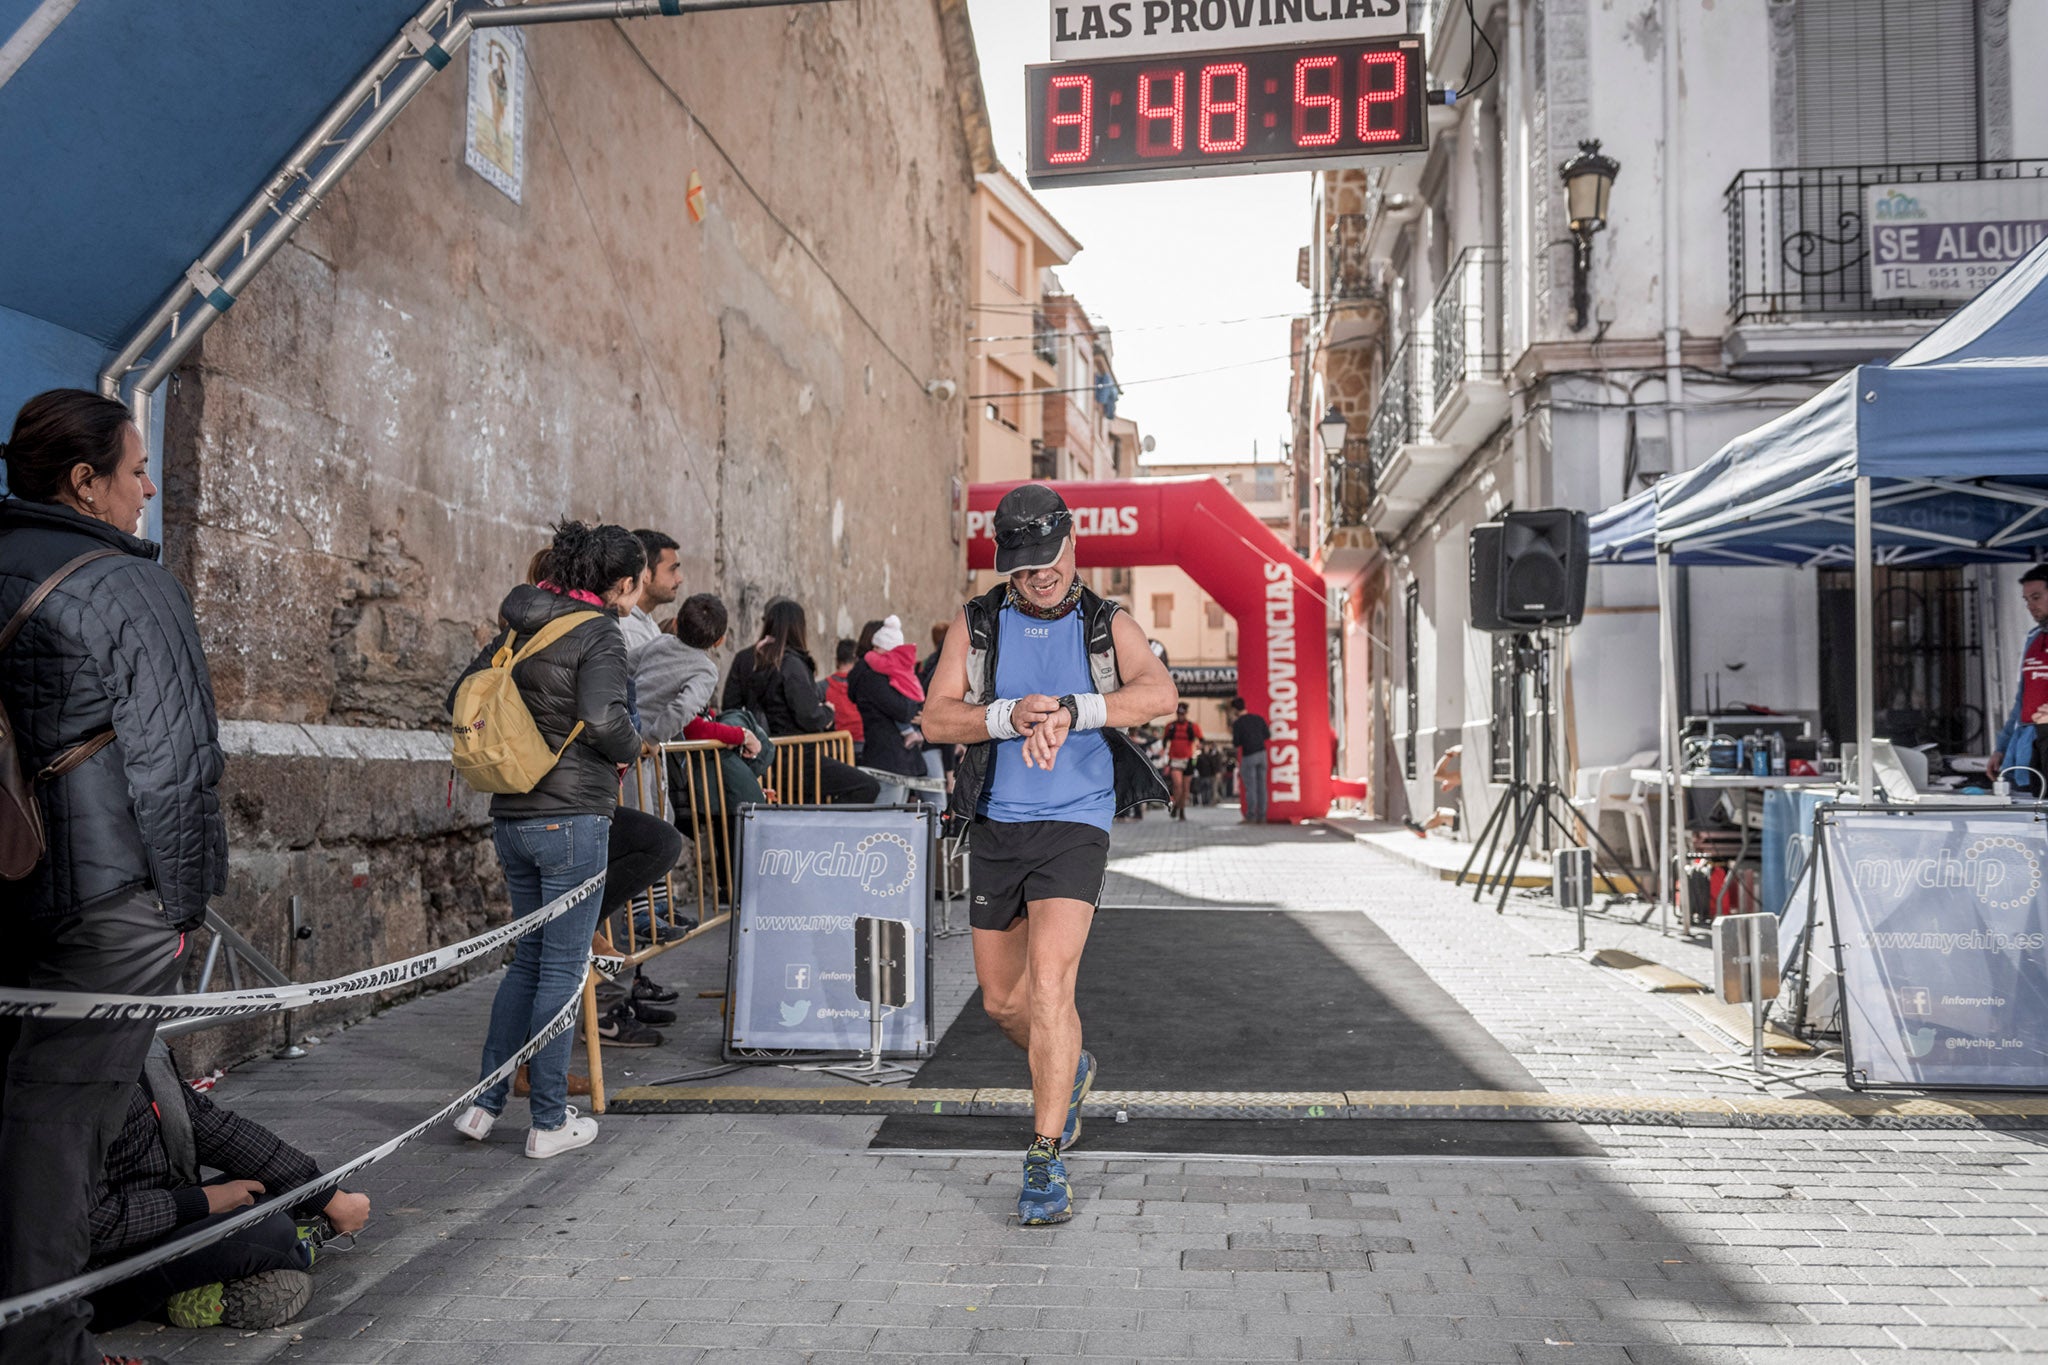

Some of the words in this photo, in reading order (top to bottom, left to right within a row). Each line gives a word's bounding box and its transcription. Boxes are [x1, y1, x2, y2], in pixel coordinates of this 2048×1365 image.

[1056, 3, 1132, 42] LAS
[1879, 228, 1920, 261] SE
[1966, 265, 1997, 277] 930
[1024, 627, 1049, 636] GORE
[1264, 562, 1299, 741] PROVINCIAS
[1170, 669, 1238, 683] OWERAD
[1271, 745, 1301, 803] LAS
[758, 842, 888, 886] mychip
[1855, 849, 2006, 897] mychip
[1857, 929, 2044, 954] www.mychip.es
[1941, 996, 2006, 1006] /infomychip
